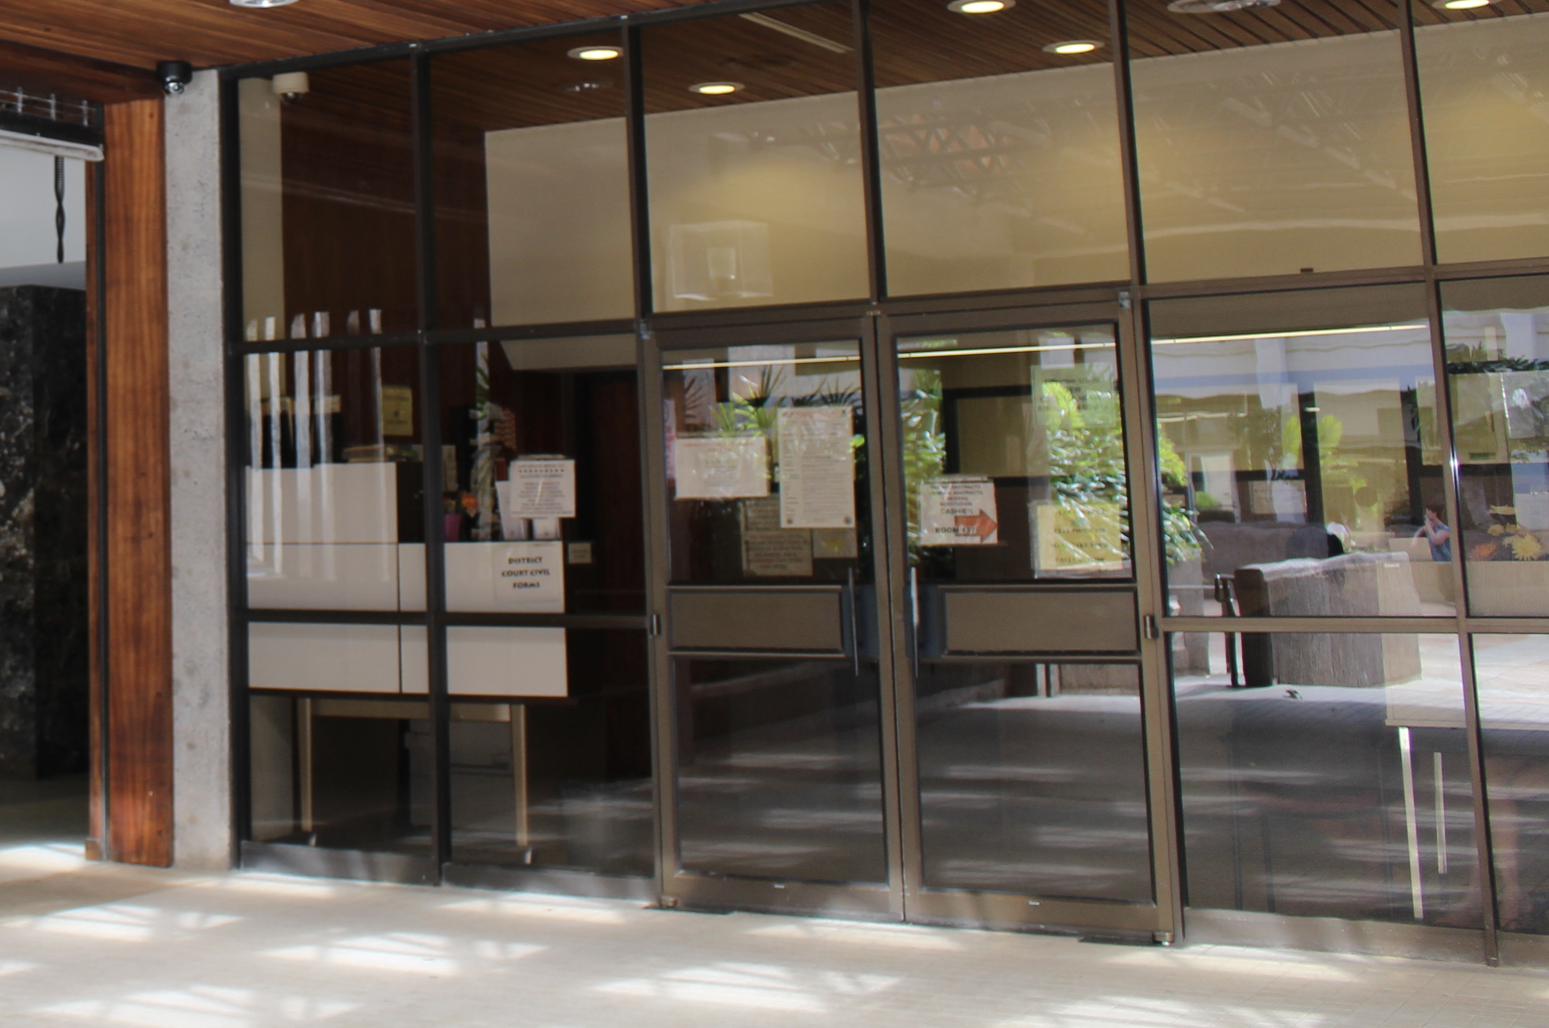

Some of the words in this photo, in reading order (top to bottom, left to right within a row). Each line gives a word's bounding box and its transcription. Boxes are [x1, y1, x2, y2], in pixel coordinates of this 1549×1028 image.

[508, 556, 543, 565] DISTRICT
[501, 569, 528, 578] COURT
[512, 581, 540, 590] FORMS
